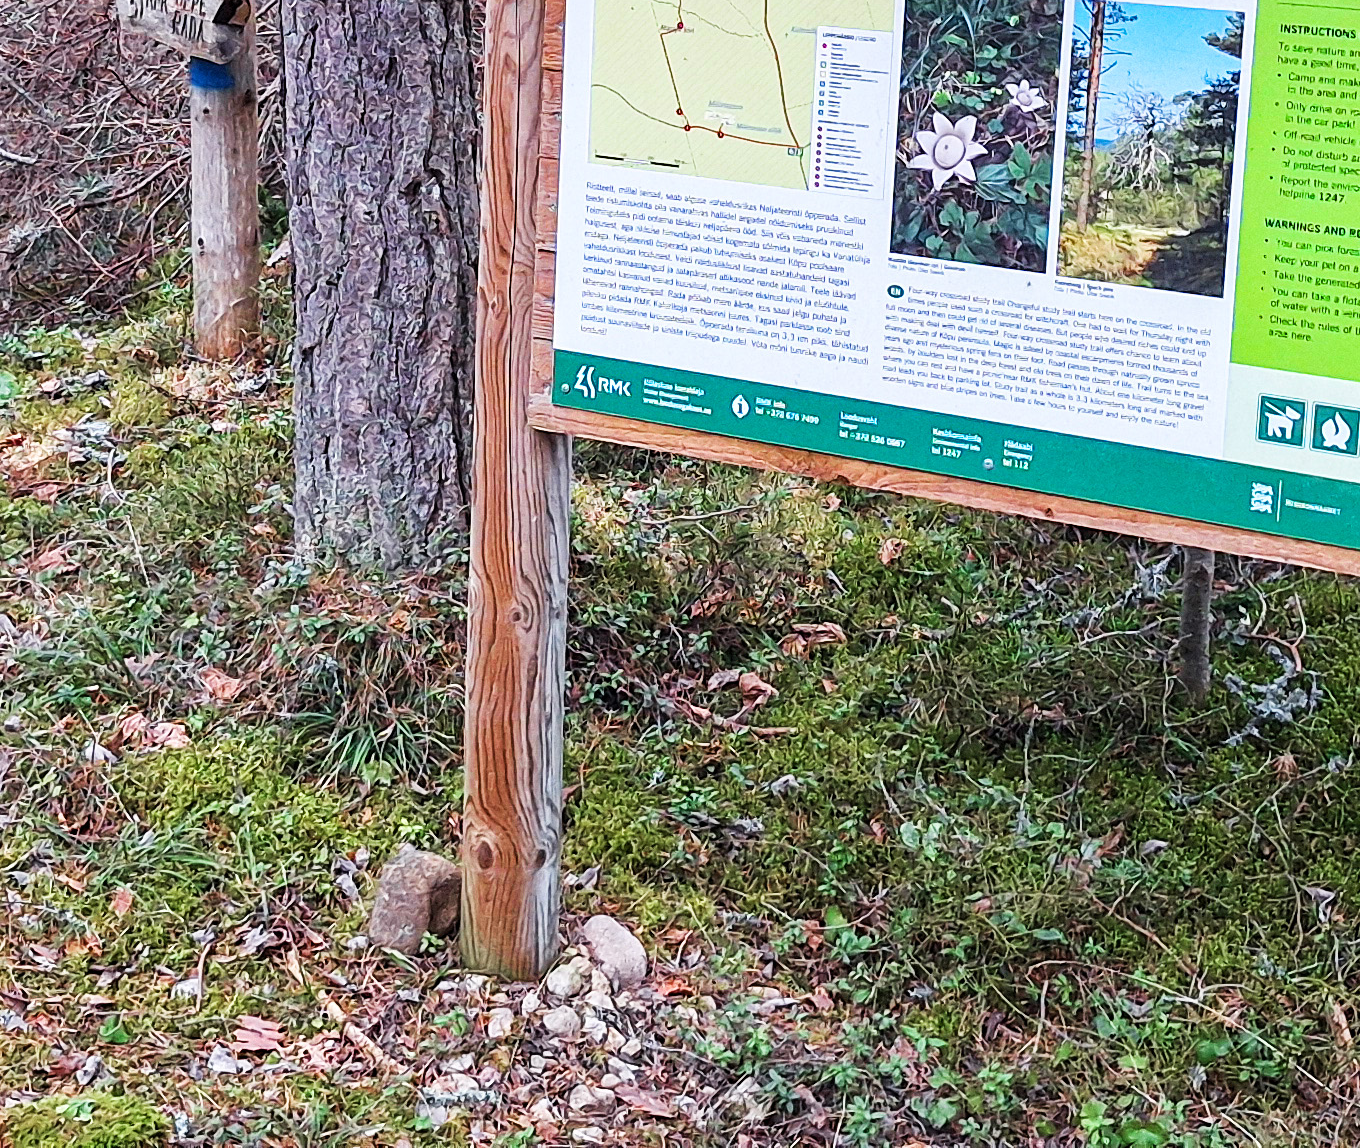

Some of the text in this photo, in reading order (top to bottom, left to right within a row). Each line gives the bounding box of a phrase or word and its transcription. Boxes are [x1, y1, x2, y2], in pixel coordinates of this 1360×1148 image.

[170, 10, 206, 42] RADA
[1280, 24, 1356, 38] INSTRUCTIONS
[1288, 71, 1315, 83] Camp
[1282, 145, 1295, 155] Do
[1319, 191, 1346, 202] 1247.
[1264, 218, 1320, 232] WARNINGS
[1323, 225, 1345, 235] AND
[598, 376, 631, 397] RMK
[942, 448, 962, 458] 1247
[1014, 460, 1029, 470] 112
